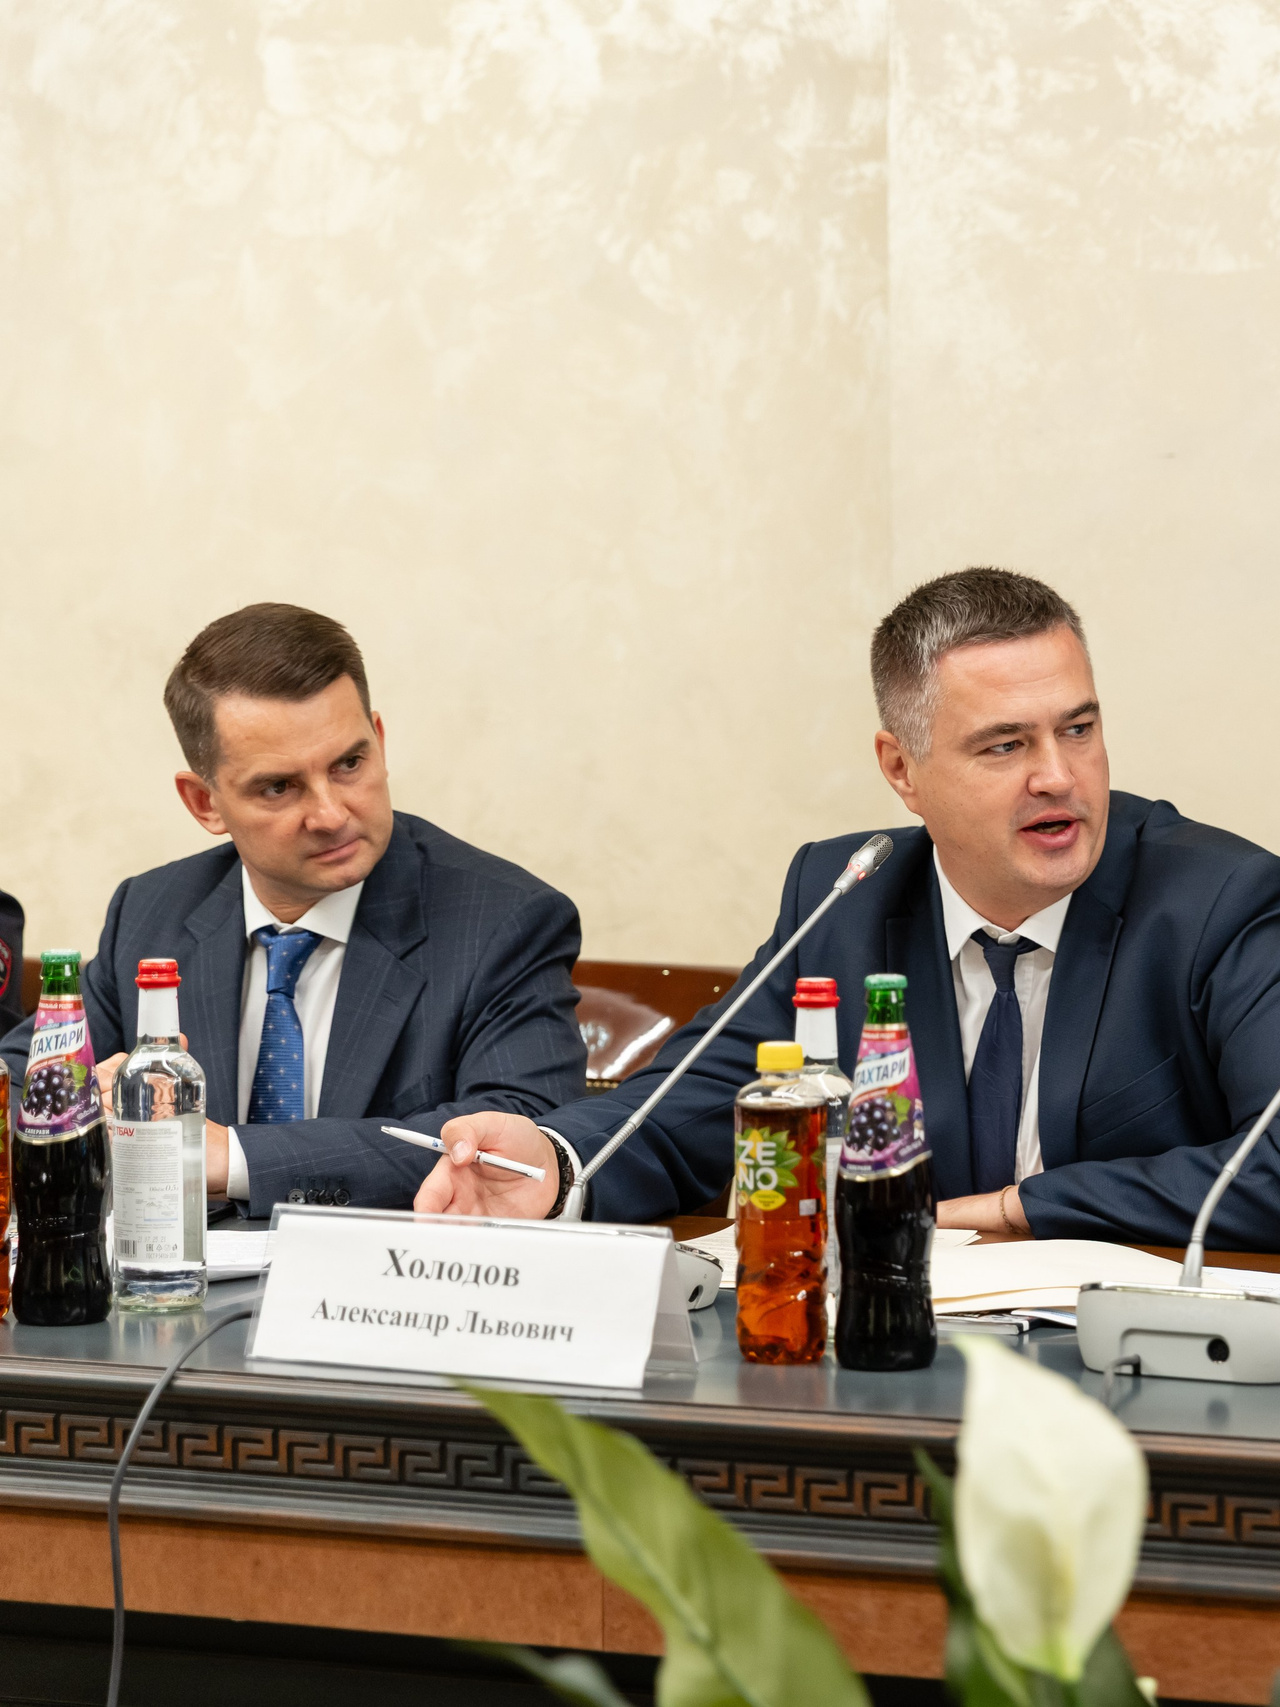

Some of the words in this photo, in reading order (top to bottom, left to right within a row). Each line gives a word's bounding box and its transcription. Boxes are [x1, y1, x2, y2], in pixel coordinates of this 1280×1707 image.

[381, 1247, 521, 1288] Холодов
[311, 1298, 449, 1337] Александр
[456, 1310, 574, 1343] Львович
